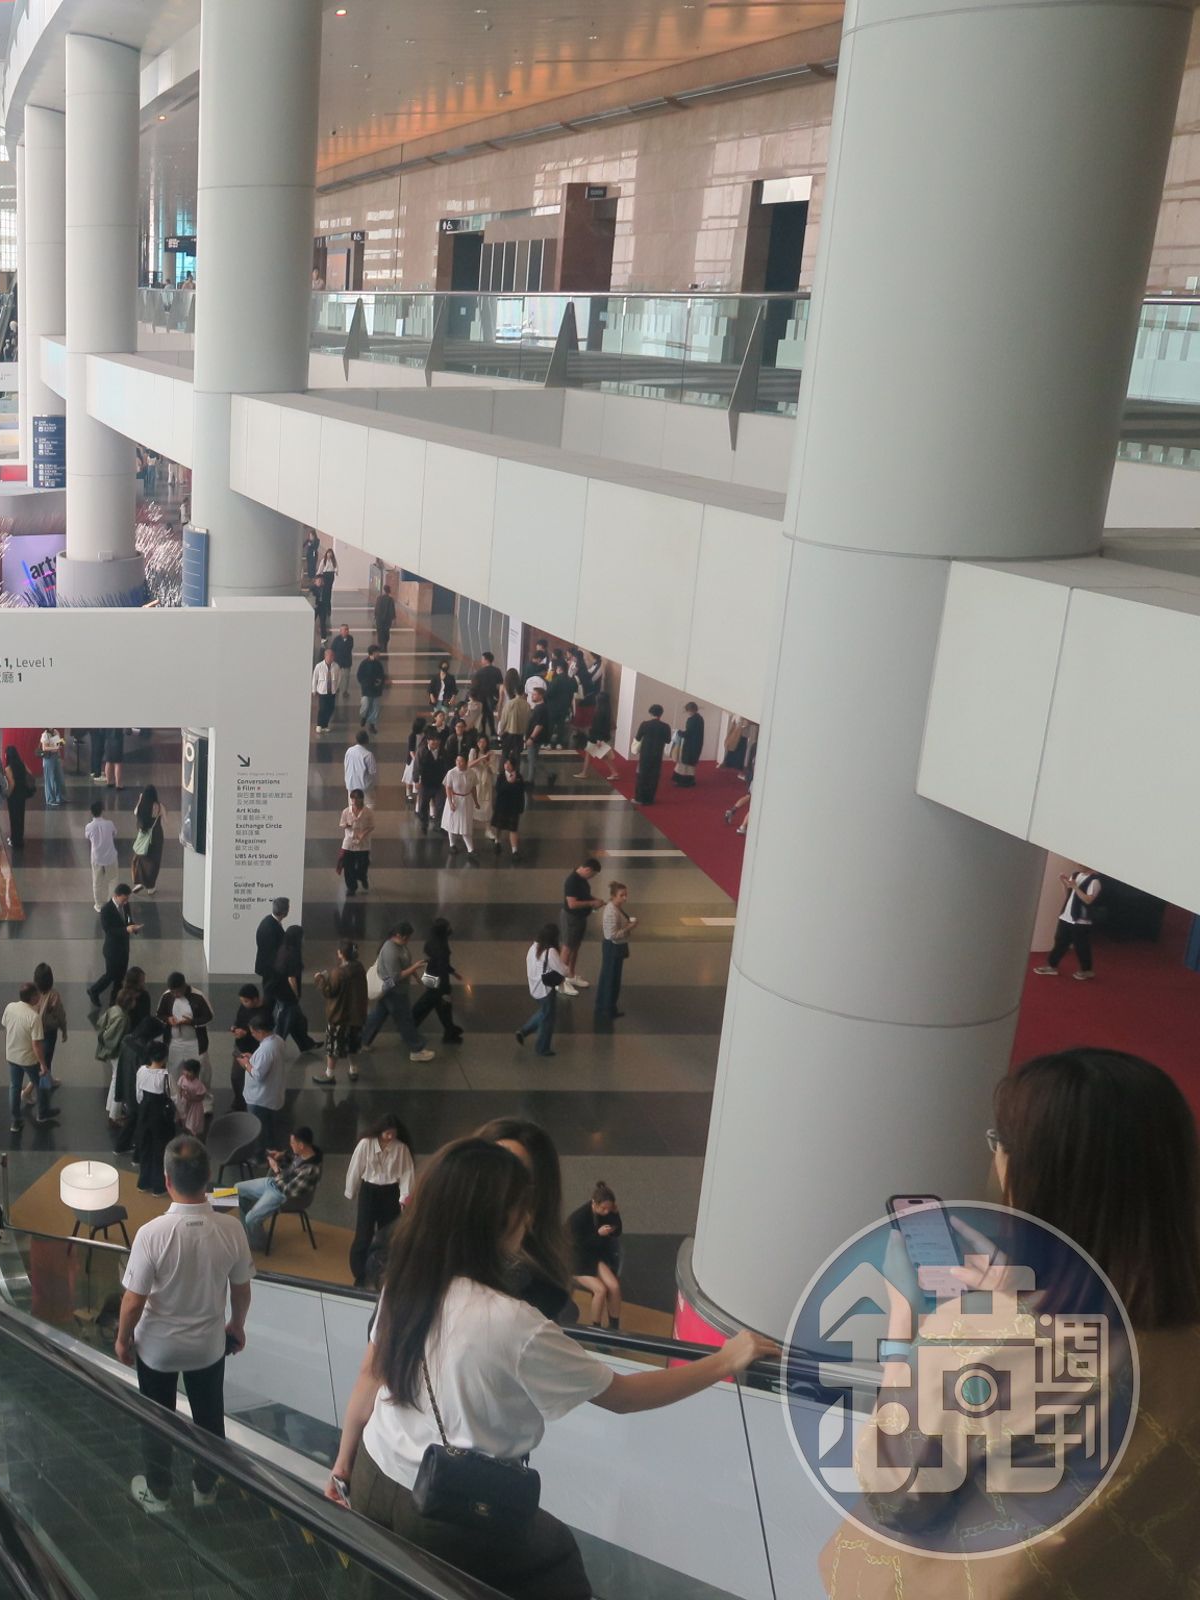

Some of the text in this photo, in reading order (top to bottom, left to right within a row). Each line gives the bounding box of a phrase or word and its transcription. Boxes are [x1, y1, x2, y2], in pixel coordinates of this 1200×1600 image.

[4, 657, 13, 670] 1,
[16, 657, 46, 668] Level
[49, 657, 53, 668] 1
[17, 672, 22, 682] 1
